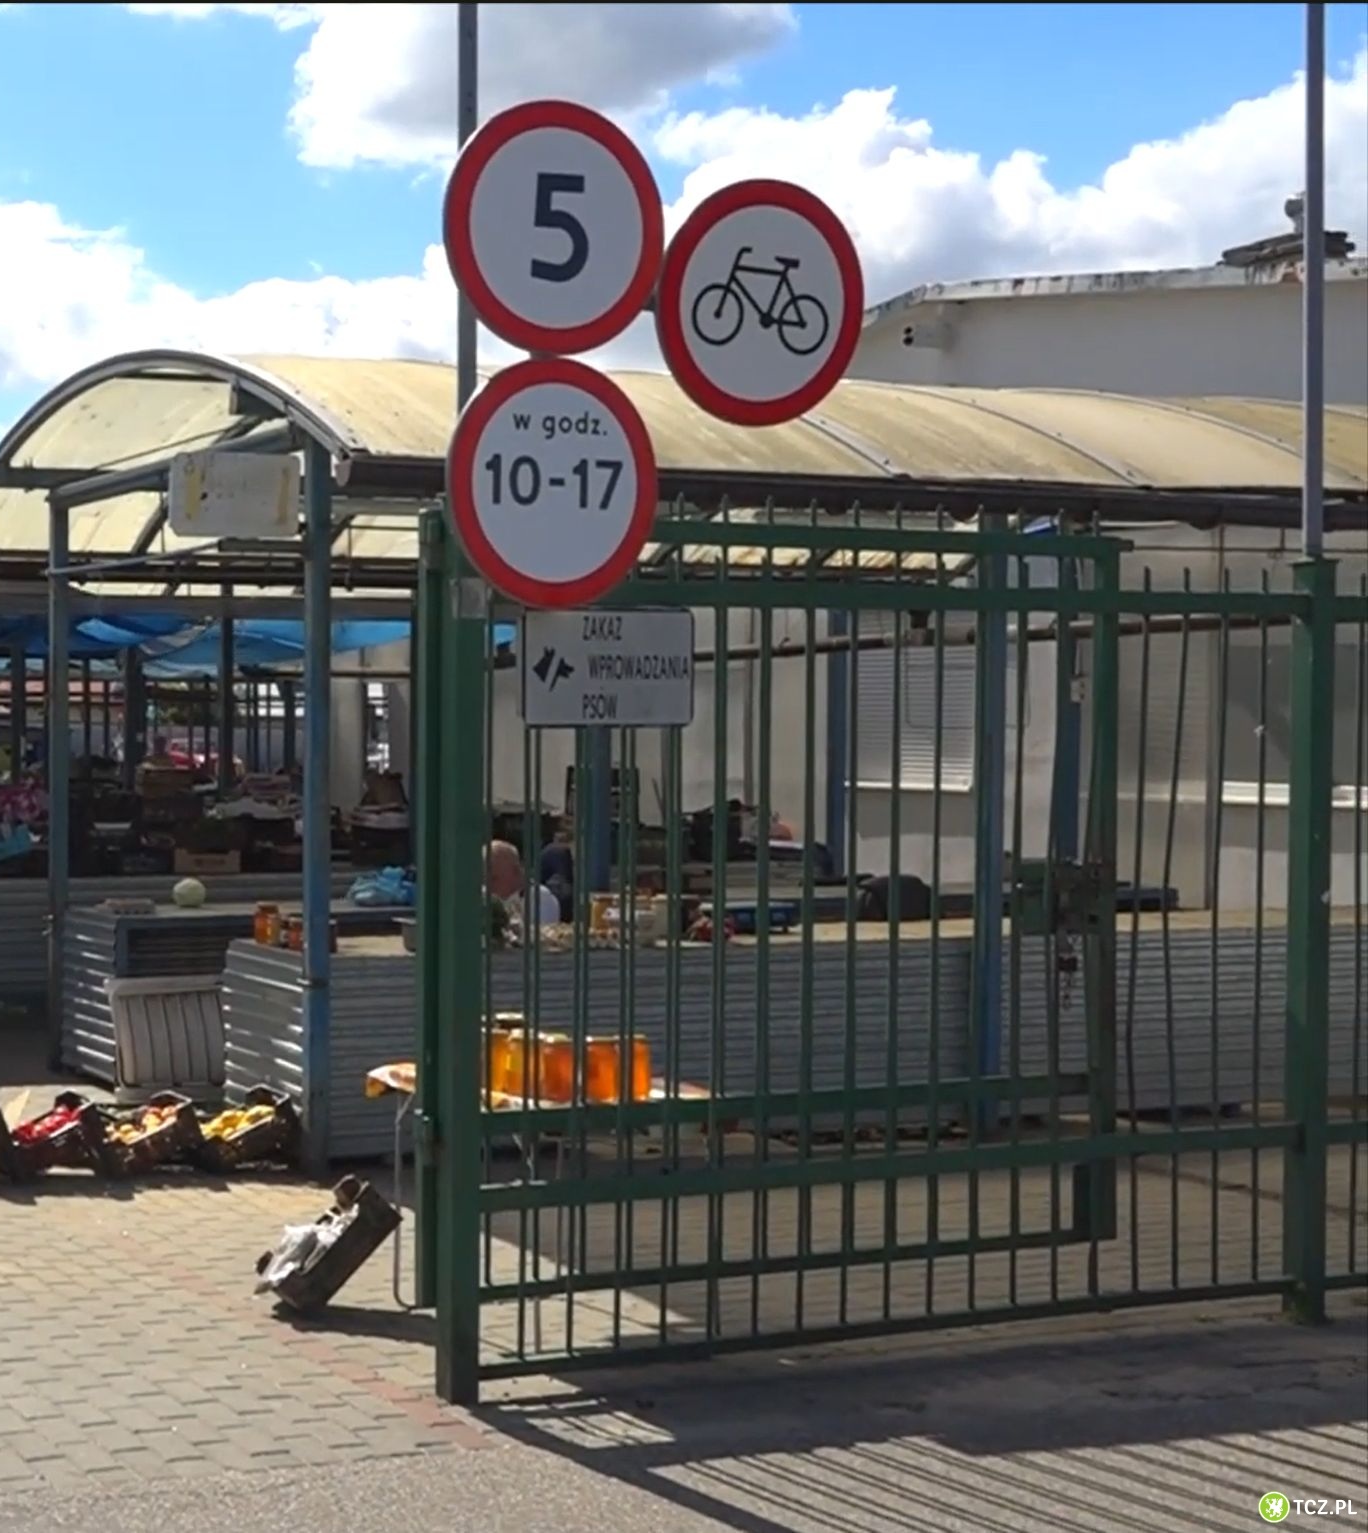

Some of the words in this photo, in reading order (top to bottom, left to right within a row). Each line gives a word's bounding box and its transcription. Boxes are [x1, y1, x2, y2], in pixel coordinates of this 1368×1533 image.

[530, 172, 589, 283] 5
[513, 413, 531, 430] w
[542, 411, 608, 440] godz.
[485, 453, 623, 510] 10-17
[583, 616, 623, 641] ZAKAZ
[588, 655, 689, 680] WPROWADZANIA
[583, 686, 618, 719] PSÓW
